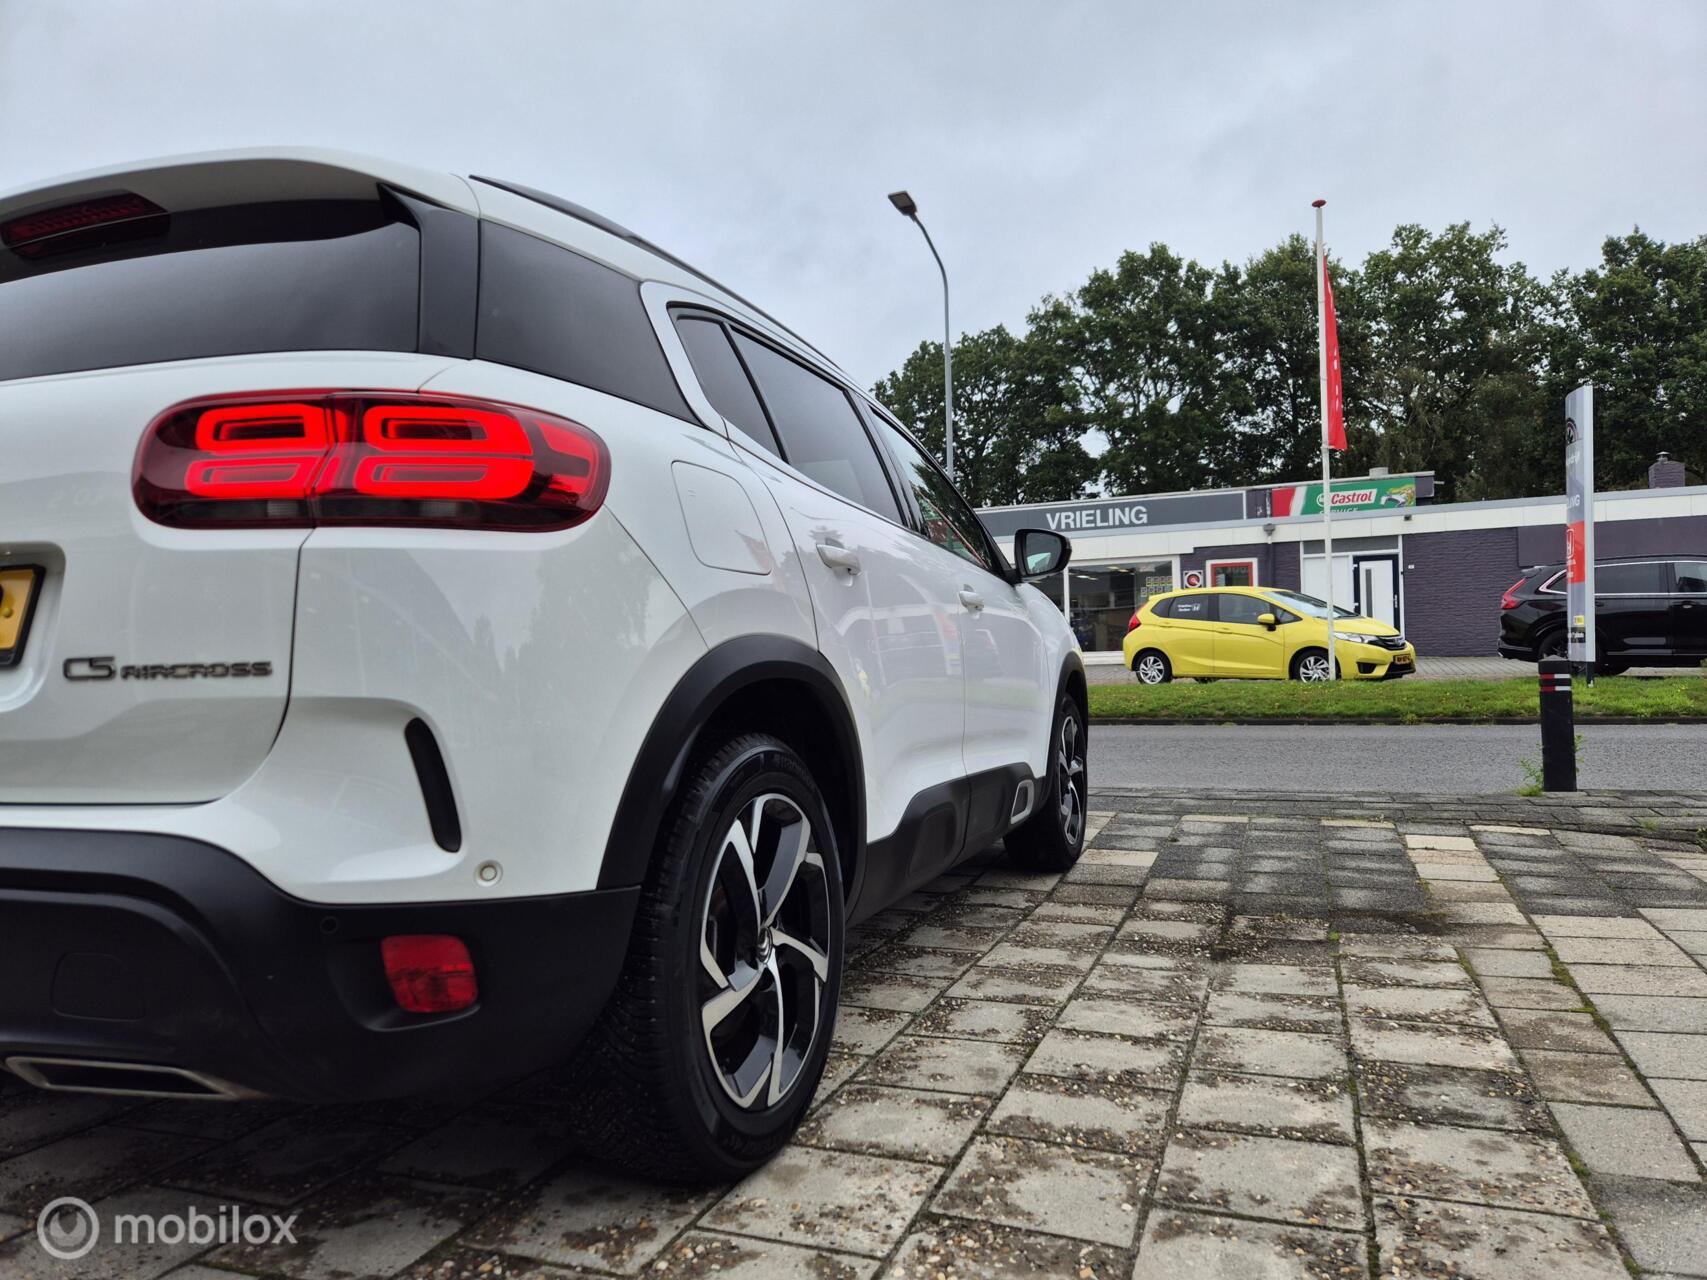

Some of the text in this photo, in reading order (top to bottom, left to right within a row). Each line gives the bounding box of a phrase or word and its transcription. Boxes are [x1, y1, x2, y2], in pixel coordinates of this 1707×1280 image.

[1331, 492, 1372, 504] Castrol
[1046, 506, 1148, 530] VRIELING
[63, 656, 273, 681] C5 AIRCROSS
